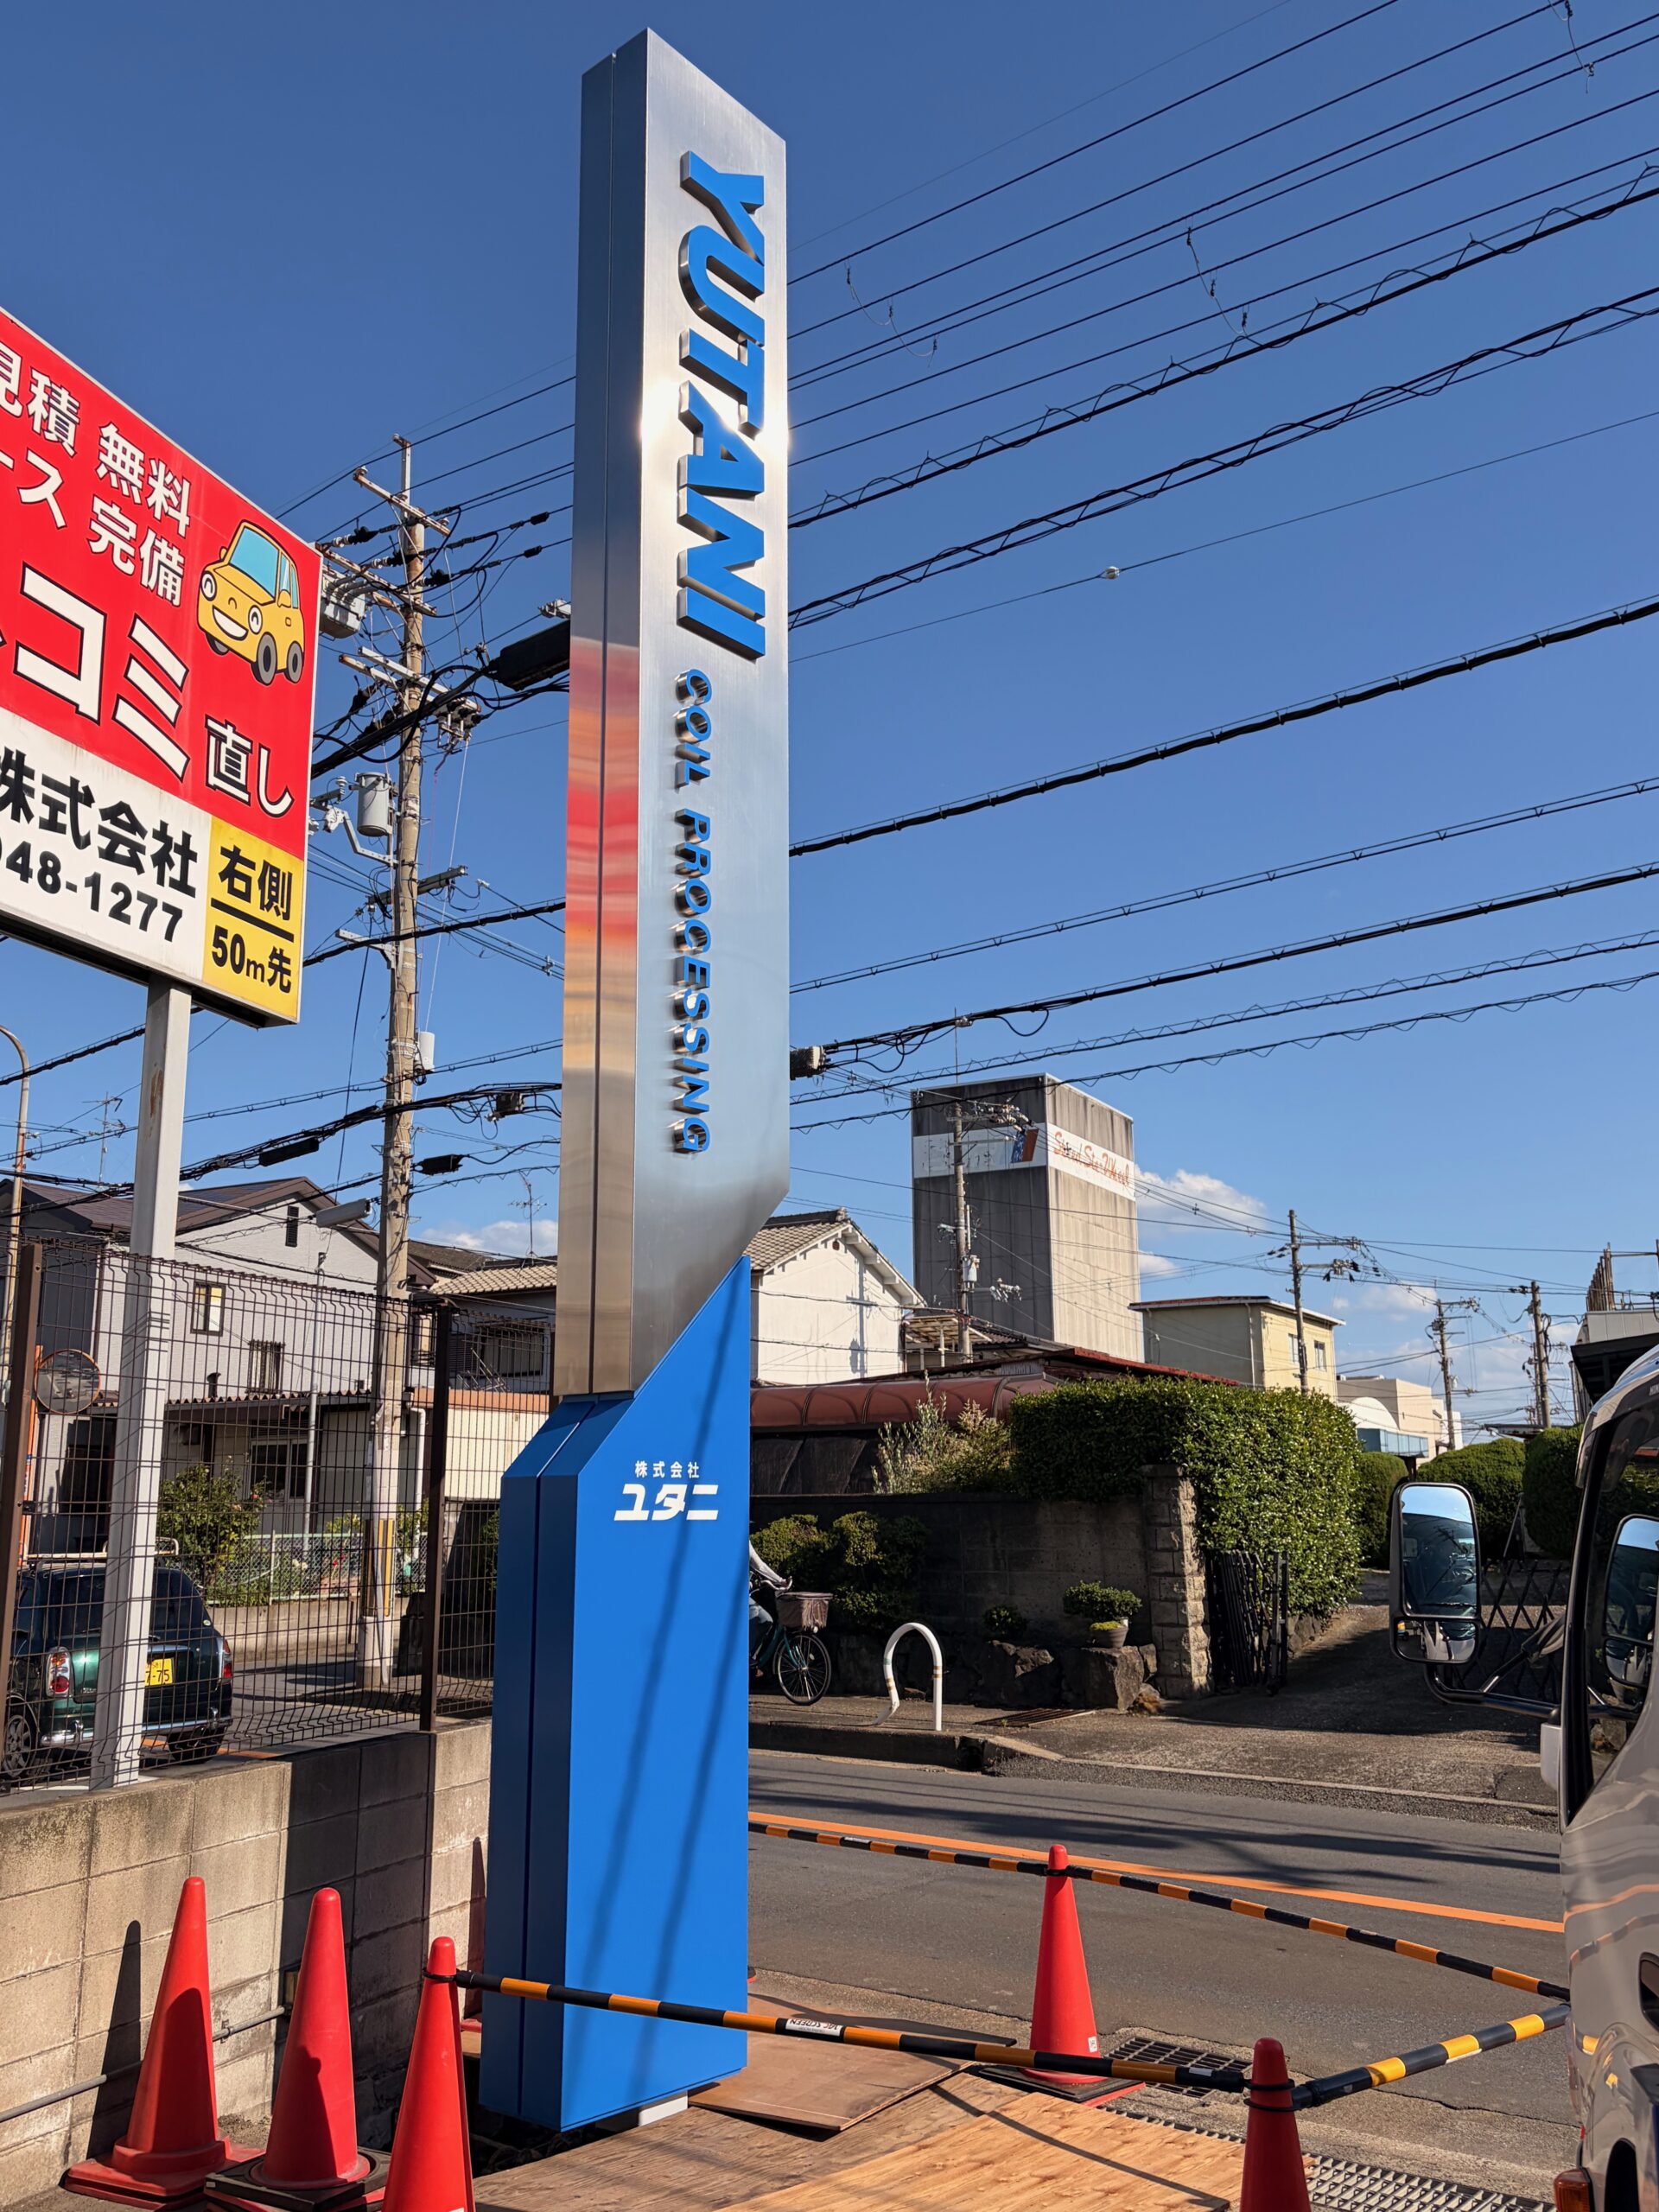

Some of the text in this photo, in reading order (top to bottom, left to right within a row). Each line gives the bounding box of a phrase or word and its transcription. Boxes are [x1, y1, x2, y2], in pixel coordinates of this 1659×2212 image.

[681, 150, 765, 661] YUTANI
[96, 422, 191, 539] 無料
[87, 494, 186, 607] 完備
[0, 747, 198, 899] 株式会社
[0, 836, 183, 943] 48-1277
[219, 844, 293, 922] 右側
[680, 669, 712, 1154] COIL PROCESSING
[211, 925, 292, 994] 50m先
[613, 1484, 718, 1521] ユタニ
[635, 1460, 699, 1478] 株式会社
